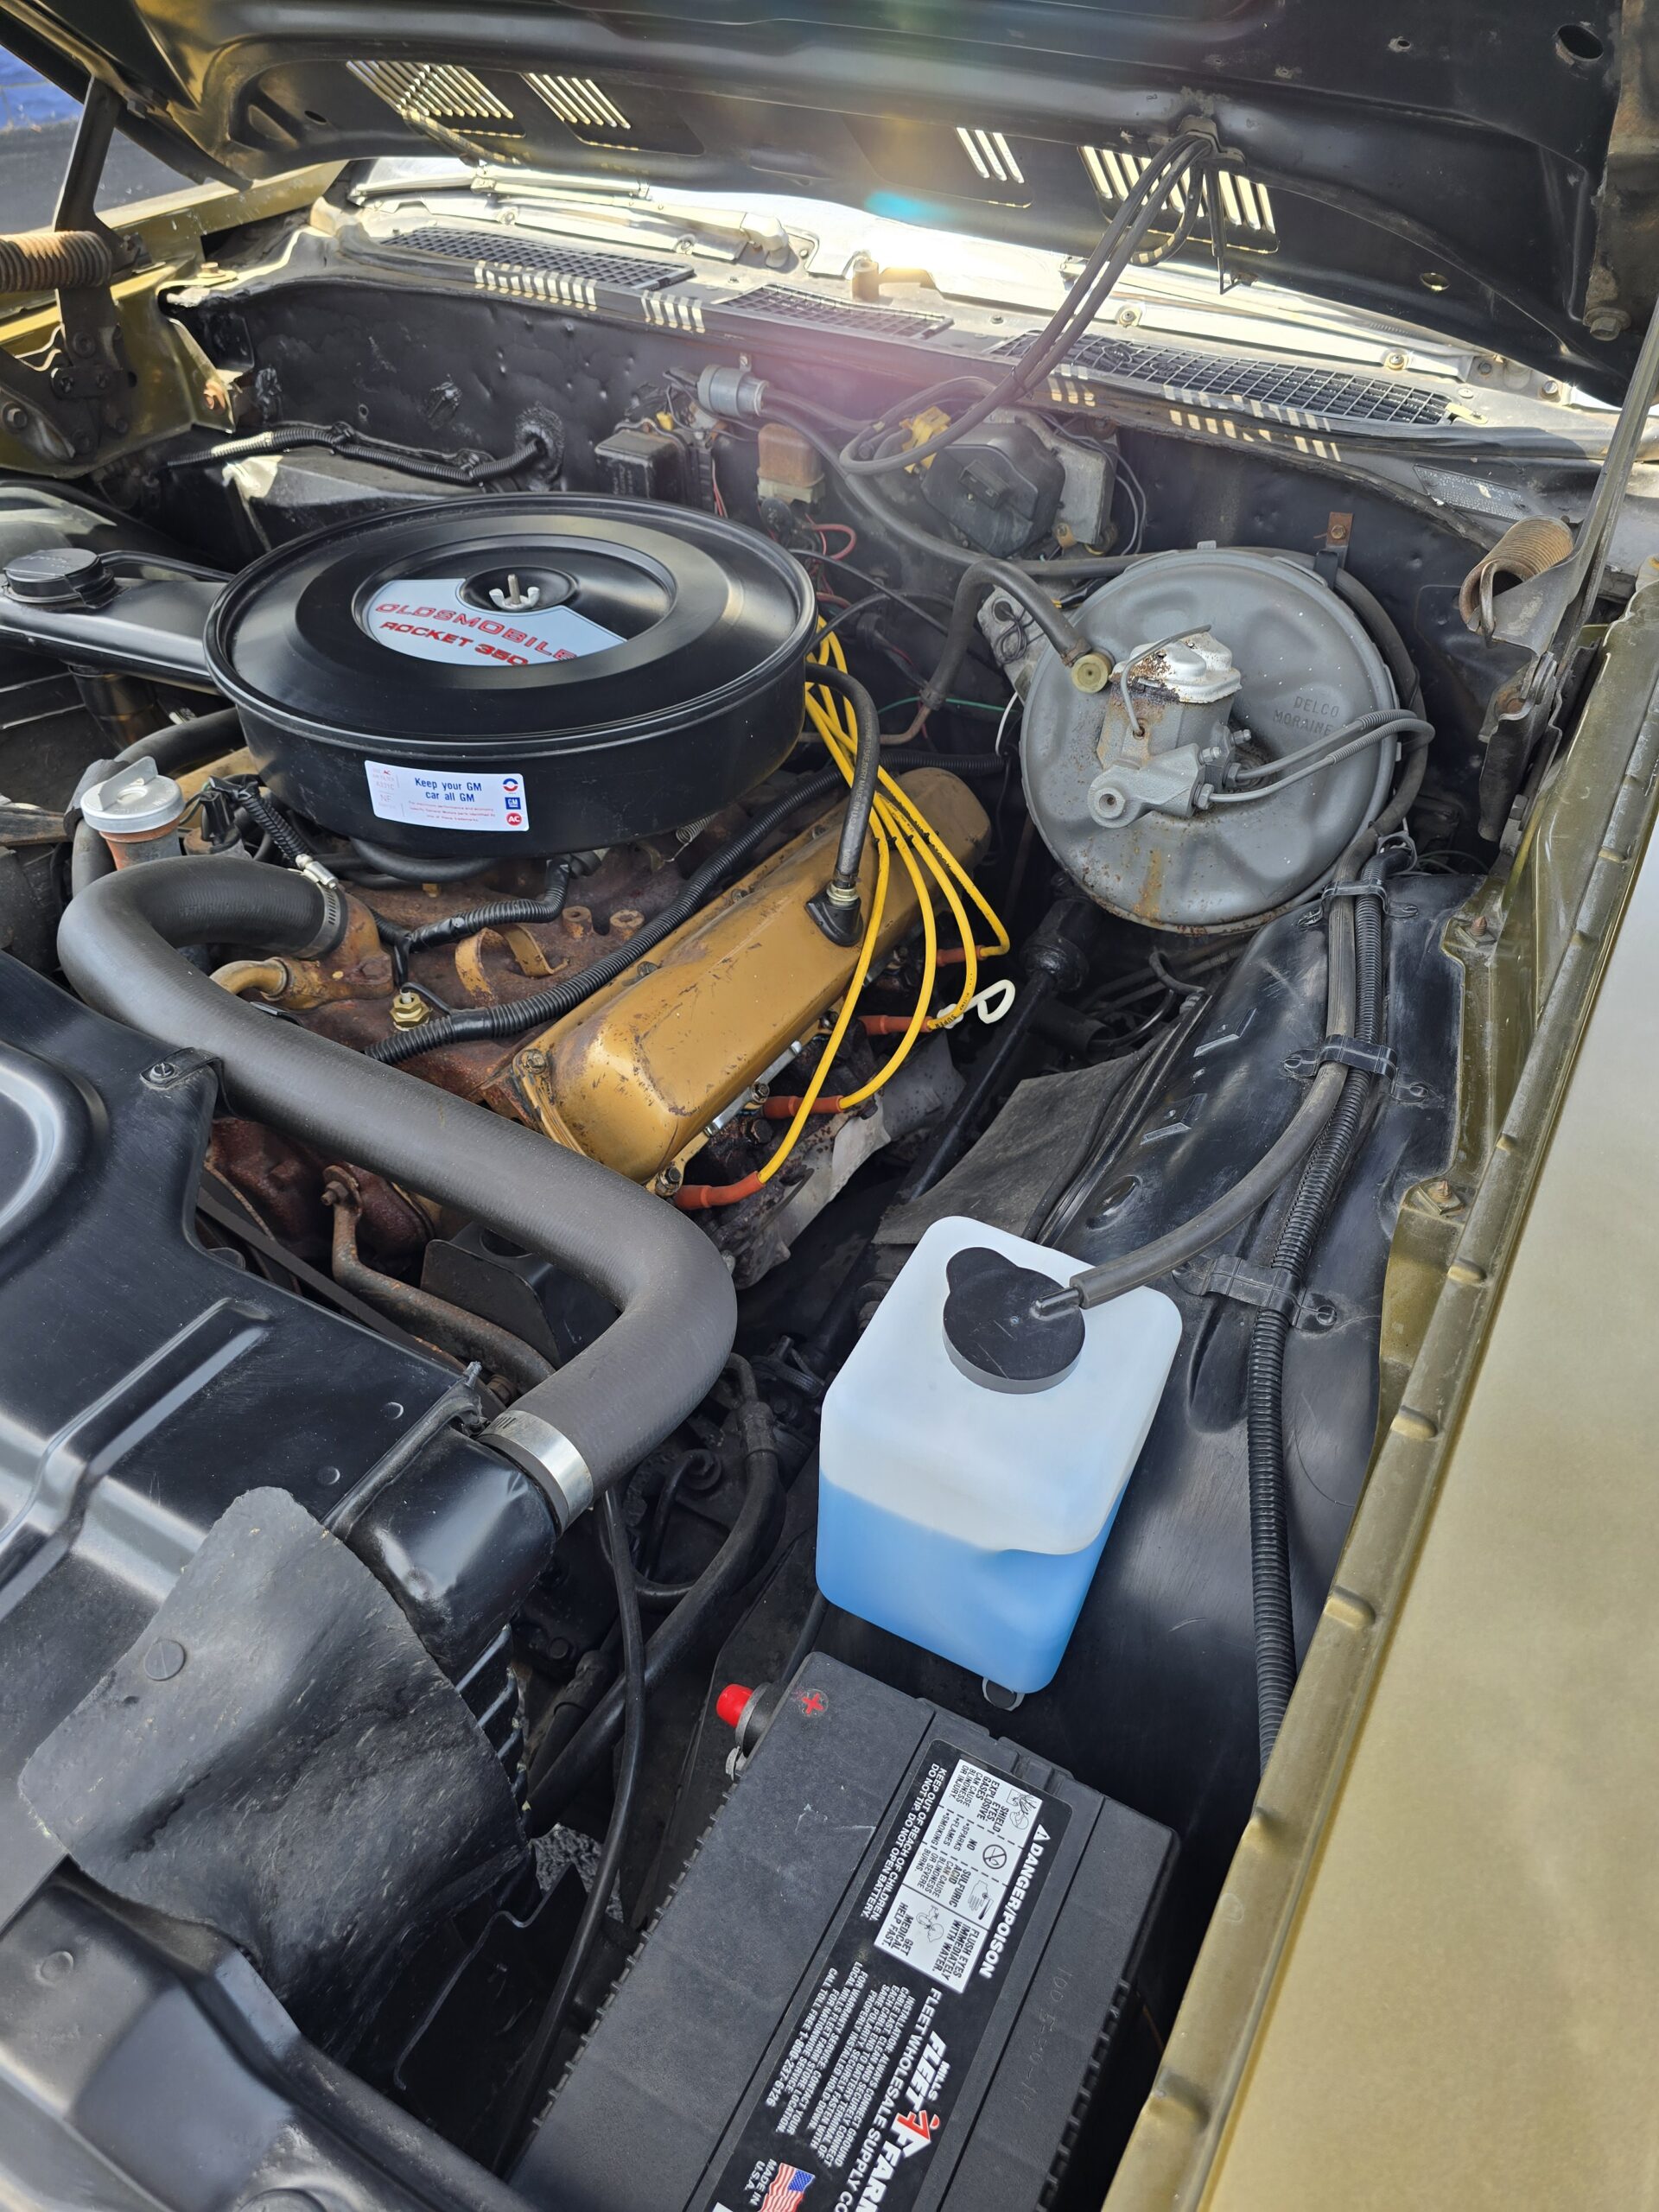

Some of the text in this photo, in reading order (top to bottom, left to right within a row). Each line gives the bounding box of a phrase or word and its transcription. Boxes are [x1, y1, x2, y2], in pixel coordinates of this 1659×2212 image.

[375, 603, 577, 660] OLDSMOBILE
[380, 621, 530, 665] ROCKET 350
[1273, 709, 1334, 736] MORAINE
[1294, 696, 1339, 718] DELCO
[415, 778, 482, 791] Keep your GM
[445, 792, 455, 801] all
[460, 793, 474, 802] GM
[918, 1777, 933, 1797] NOT
[927, 1762, 940, 1777] DO
[948, 1764, 969, 1799] OR INJURY.
[955, 1767, 976, 1804] BLINDNESS
[975, 1775, 992, 1801] GASES
[962, 1771, 983, 1808] CAN CAUSE
[976, 1779, 1001, 1821] EXPLOSIVE
[904, 1811, 917, 1827] DO
[984, 1801, 1001, 1821] EYES.
[991, 1805, 1009, 1833] SHIELD
[868, 1767, 947, 1921] KEEP OUT OF REACH OF CHILDREN.
[894, 1826, 910, 1848] NOT
[965, 1838, 978, 1851] NO
[881, 1847, 899, 1874] OPEN
[913, 1847, 931, 1872] BURNS.
[916, 1852, 938, 1889] OR SEVERE
[924, 1855, 946, 1893] BLINDNESS
[931, 1859, 954, 1898] CAN CAUSE
[947, 1863, 963, 1885] ACID
[860, 1872, 887, 1918] BATTERY.
[948, 1868, 971, 1908] SULFURIC
[880, 1901, 908, 1947] HELP FAST.
[978, 1841, 1044, 1978] DANGER/POISON
[890, 1913, 914, 1950] MEDICAL
[899, 1937, 914, 1956] GET
[931, 1919, 963, 1972] WITH WATER.
[940, 1923, 971, 1980] IMMEDIATELY
[951, 1928, 980, 1978] FLUSH EYES
[874, 1983, 890, 2008] SAME
[891, 1986, 909, 2013] CABLE
[914, 1986, 942, 2038] FLEET
[765, 1967, 838, 2107] CALL TOLL FREE 1-800-237-6126
[774, 1961, 863, 2133] LOCAL MILLS FLEET FARM STORE LOCATION.
[784, 1987, 840, 2094] FOR NATIONWIDE SERVICE:
[785, 1970, 868, 2135] FOR WARRANTY SERVICE: CONTACT YOUR
[869, 2035, 887, 2063] CLEAN
[806, 1988, 878, 2129] PROPERLY INSTALLED HOLD-DOWN.
[817, 1984, 900, 2158] EACH CABLE END TO BATTERY TERMINAL OF
[836, 2048, 861, 2092] SECURELY
[861, 2061, 874, 2082] AND
[905, 2030, 946, 2112] FLEET
[834, 1994, 915, 2167] INSTALLATION: ALWAYS CONNECT GROUND
[872, 2033, 923, 2128] WHOLESALE
[927, 2060, 950, 2101] MILLS
[820, 2089, 842, 2125] FASTEN
[842, 2081, 867, 2126] SECURELY
[809, 2123, 826, 2149] WITH
[823, 2124, 847, 2167] CONNECT
[743, 2159, 766, 2190] U.S.A.
[846, 2126, 880, 2191] SUPPLY
[748, 2158, 777, 2206] MADE IN
